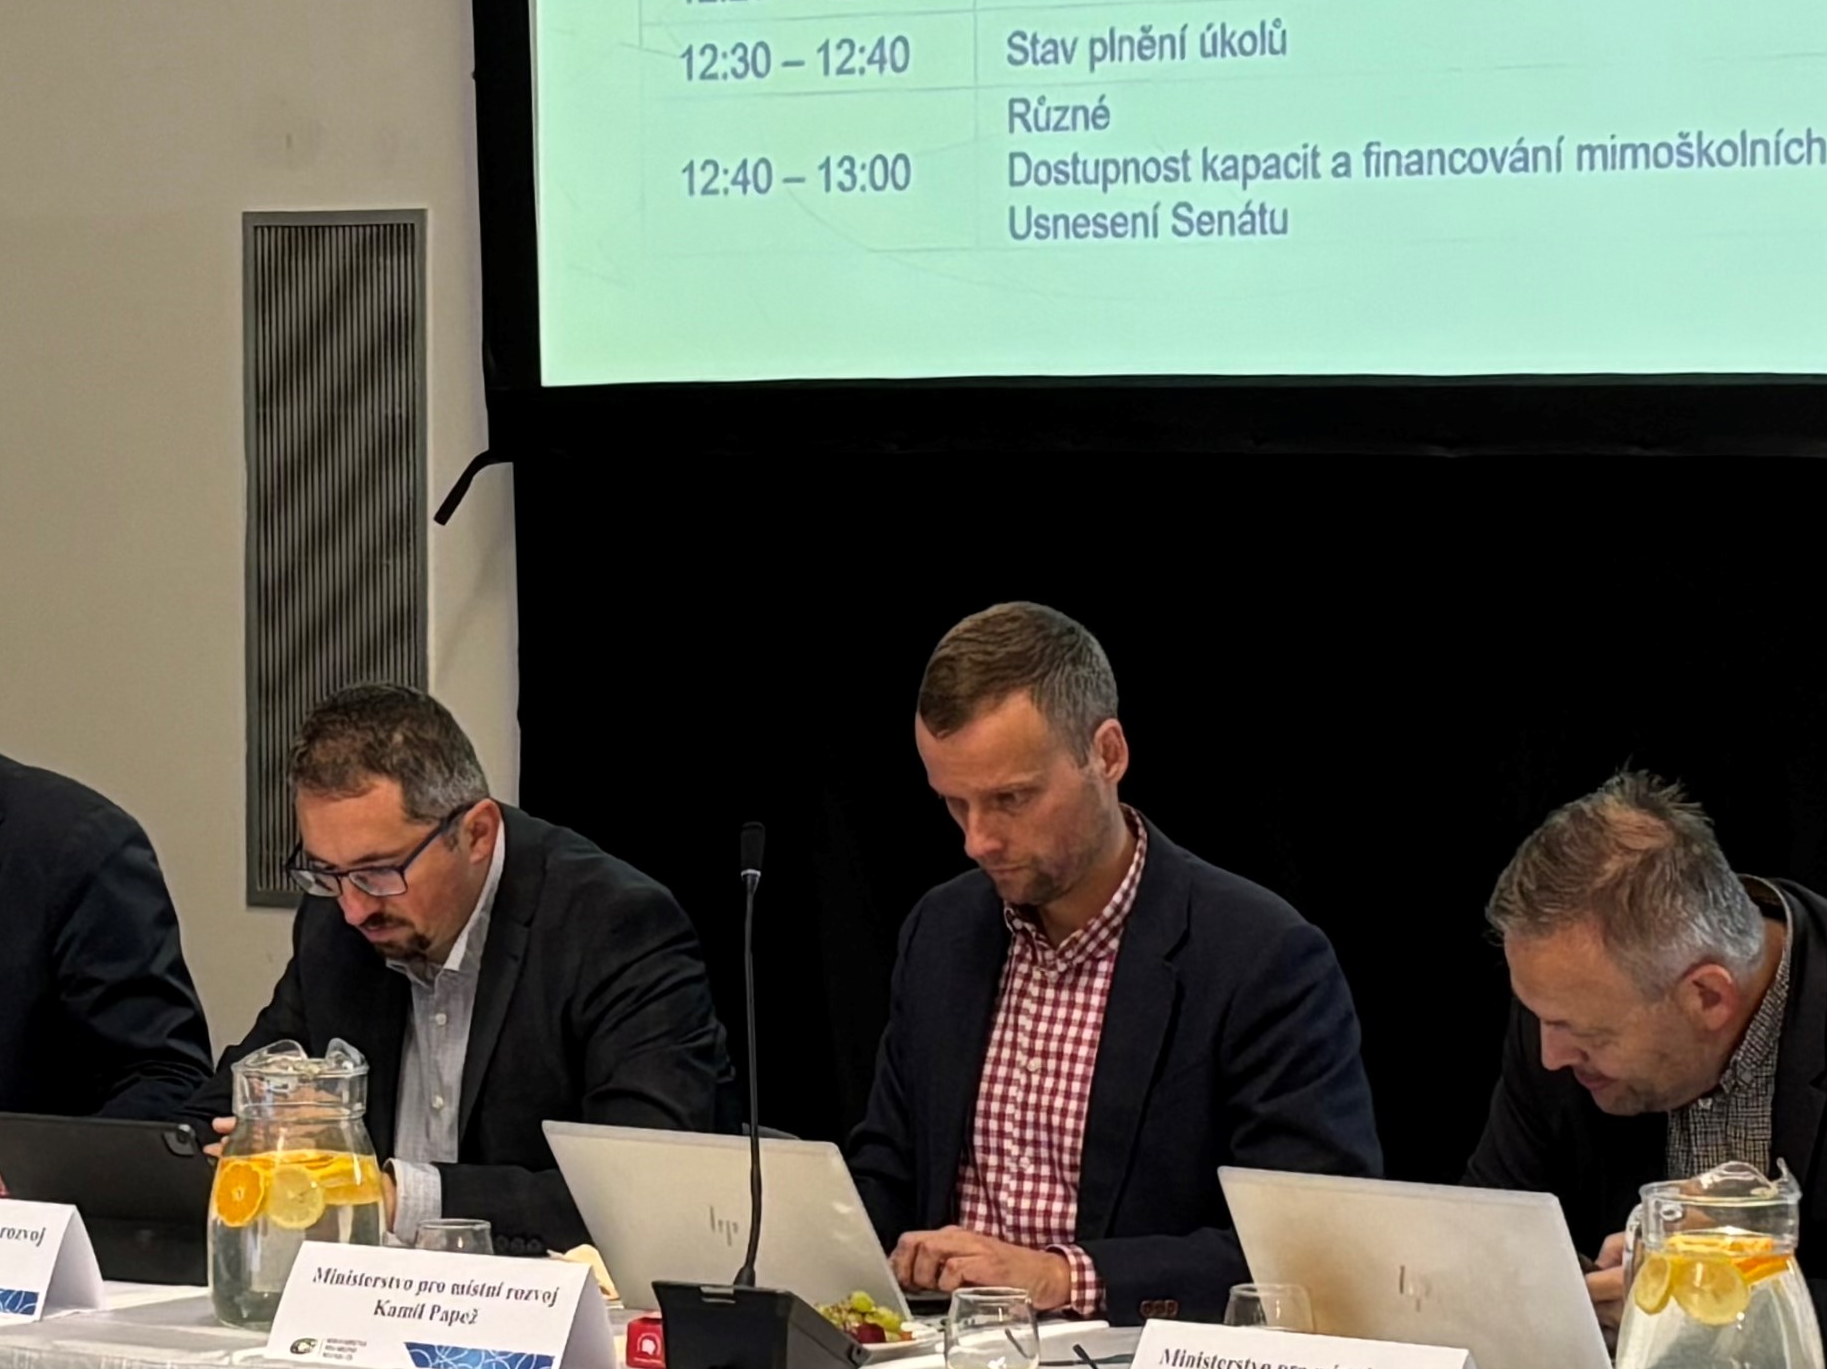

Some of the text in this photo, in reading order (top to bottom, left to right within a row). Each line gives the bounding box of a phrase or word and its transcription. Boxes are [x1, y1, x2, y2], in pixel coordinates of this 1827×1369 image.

[678, 39, 773, 83] 12:30
[815, 33, 911, 78] 12:40
[1006, 16, 1288, 74] Stav plnění úkolů
[1007, 92, 1112, 135] Různé
[680, 156, 773, 197] 12:40
[817, 152, 912, 194] 13:00
[1007, 147, 1192, 195] Dostupnost
[1200, 141, 1323, 192] kapacit
[1330, 150, 1353, 179] a
[1361, 134, 1566, 179] financování
[1575, 126, 1827, 173] mimoškolních
[1008, 198, 1289, 242] Usnesení Senátu
[0, 1225, 46, 1248] rozvoj
[312, 1266, 413, 1292] Ministerstvo
[416, 1279, 445, 1296] pro
[506, 1286, 560, 1308] rozvoj
[373, 1299, 426, 1322] Kamil
